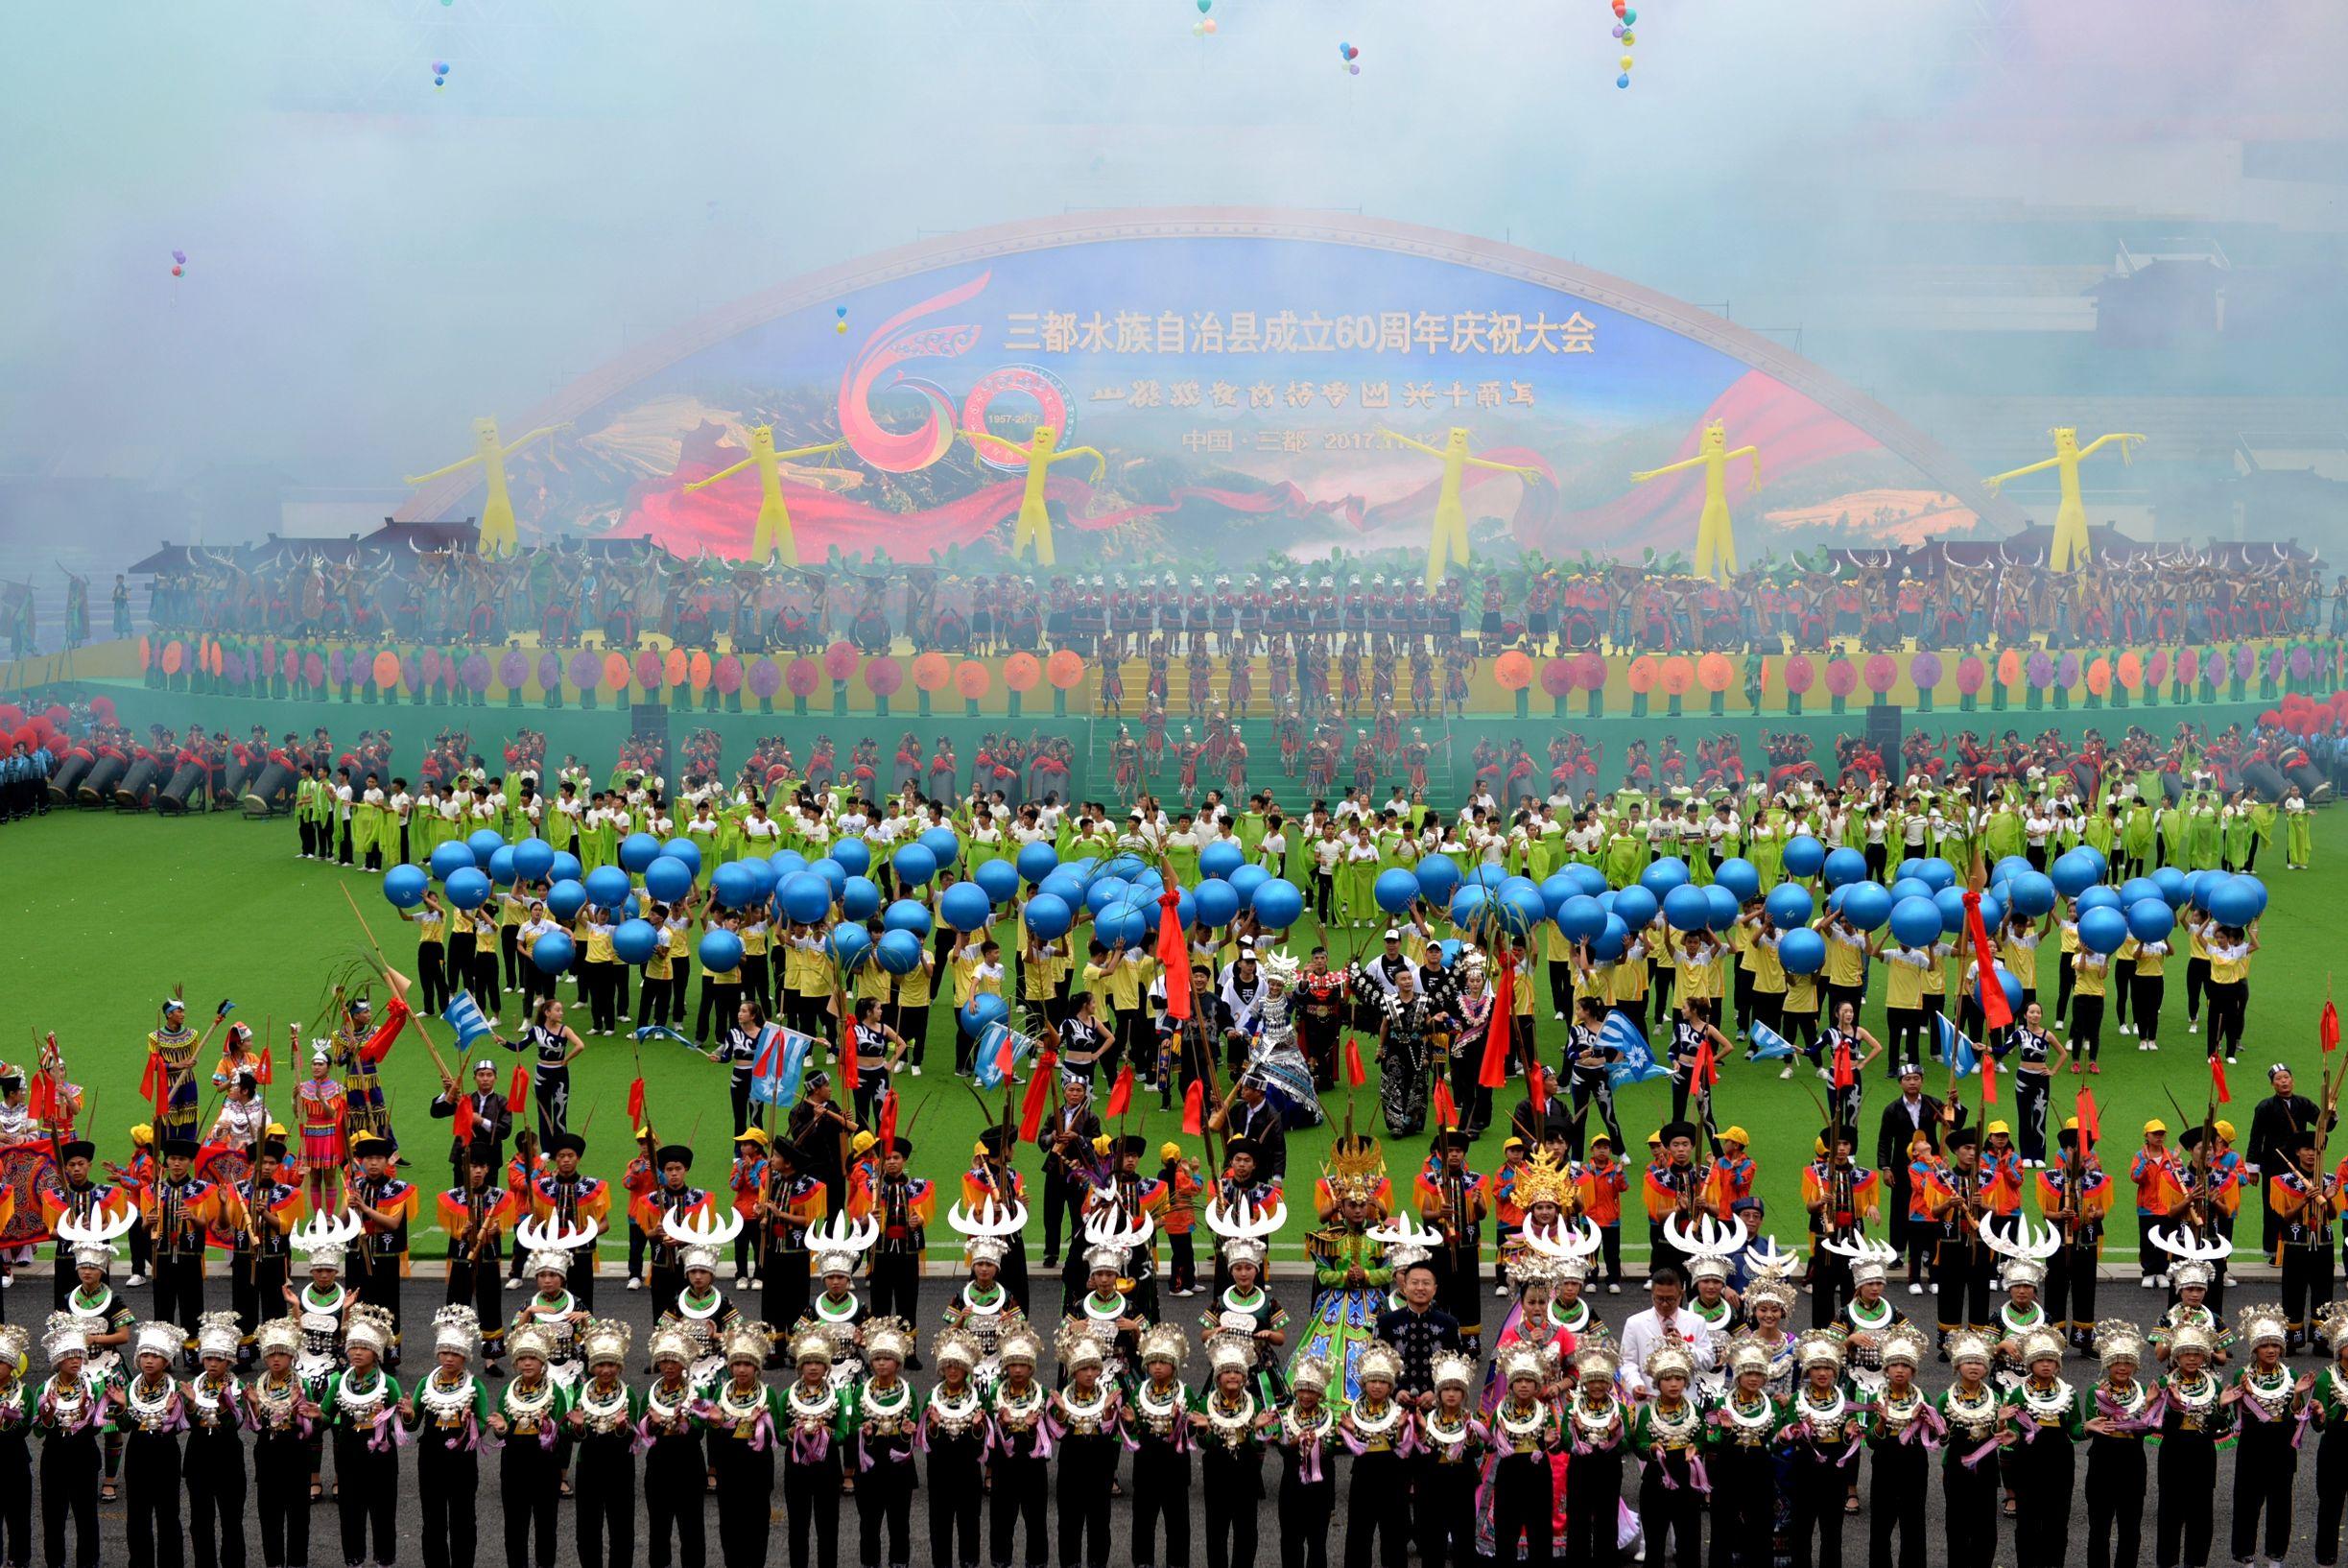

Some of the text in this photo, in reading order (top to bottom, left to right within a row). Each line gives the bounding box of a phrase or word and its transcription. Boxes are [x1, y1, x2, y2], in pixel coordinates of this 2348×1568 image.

[1005, 309, 1598, 354] 三都水族自治县成立60周年庆祝大会
[988, 415, 1038, 424] 1957-2017
